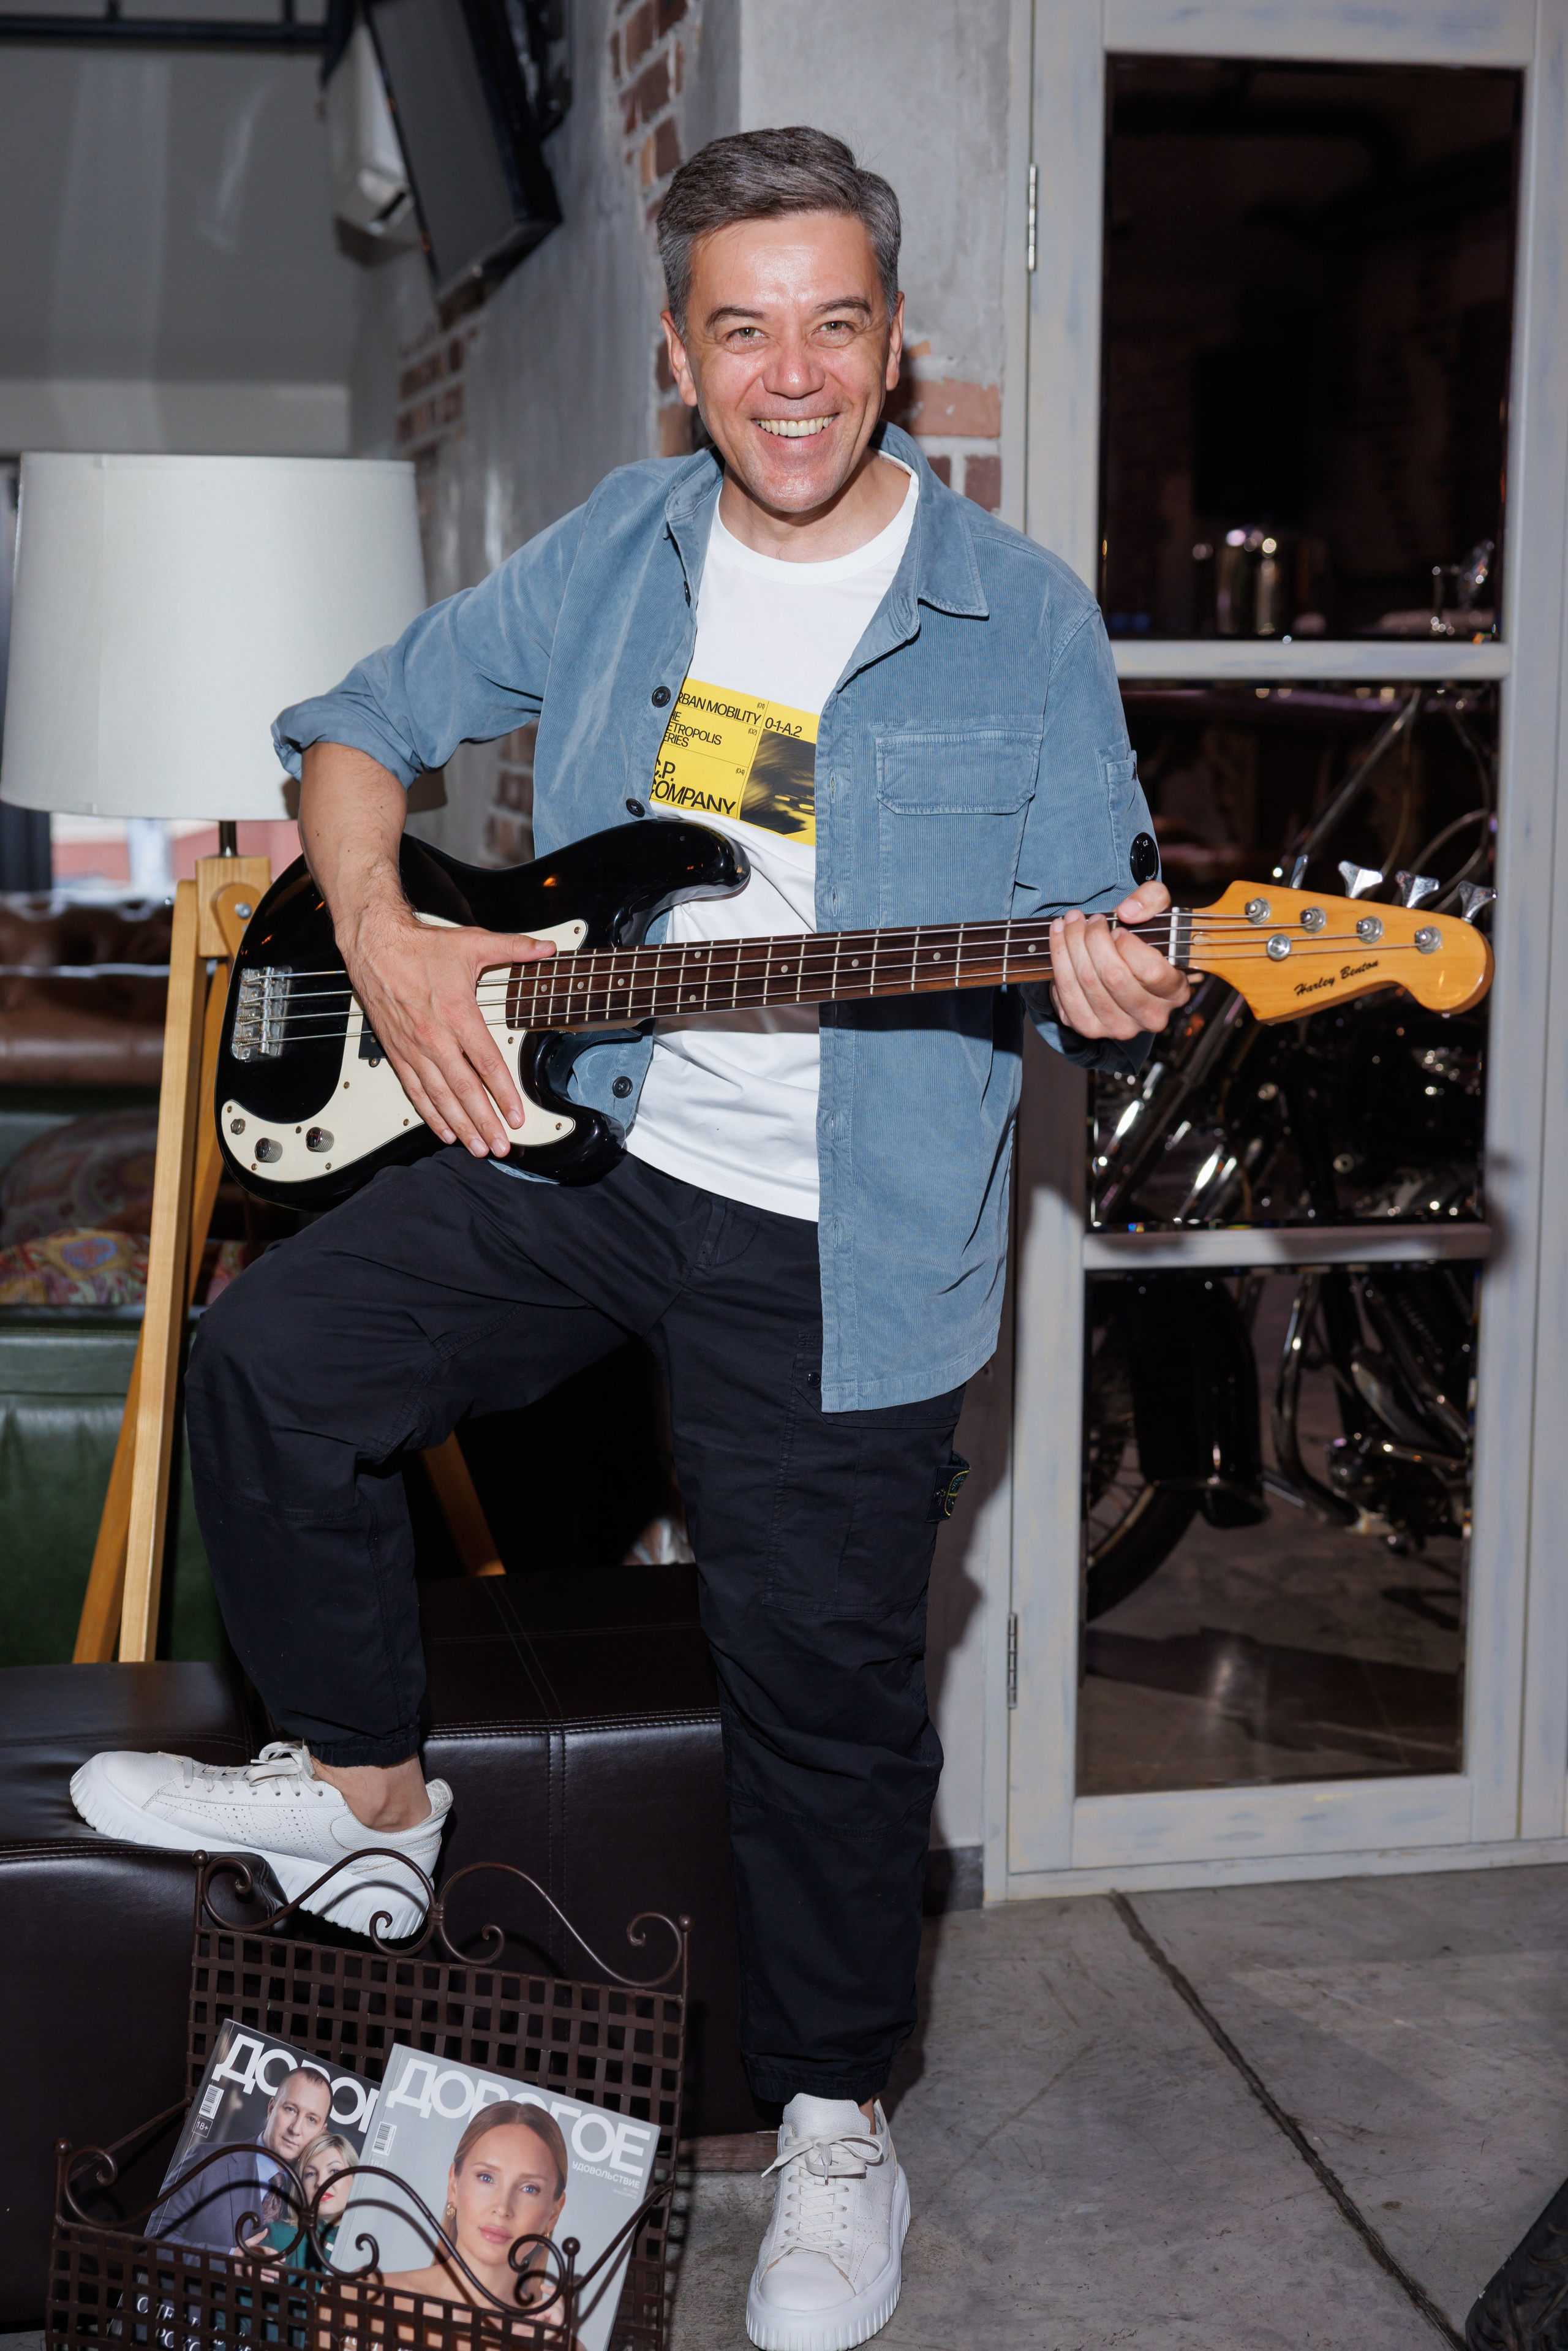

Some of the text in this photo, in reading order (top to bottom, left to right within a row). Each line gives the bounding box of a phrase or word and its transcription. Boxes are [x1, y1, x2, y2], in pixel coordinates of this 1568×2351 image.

[671, 711, 682, 722] HE
[678, 692, 761, 725] RBAN MOBILITY
[663, 731, 689, 747] ERIES
[667, 721, 722, 745] ETROPOLIS
[765, 717, 802, 738] 0-1-A.2
[651, 777, 736, 815] OMPANY
[1294, 960, 1378, 996] Harley Benton
[211, 2033, 380, 2134] ДООГ
[197, 2121, 209, 2130] 18+
[572, 2160, 641, 2189] УДОВОЛЬСТВИЕ
